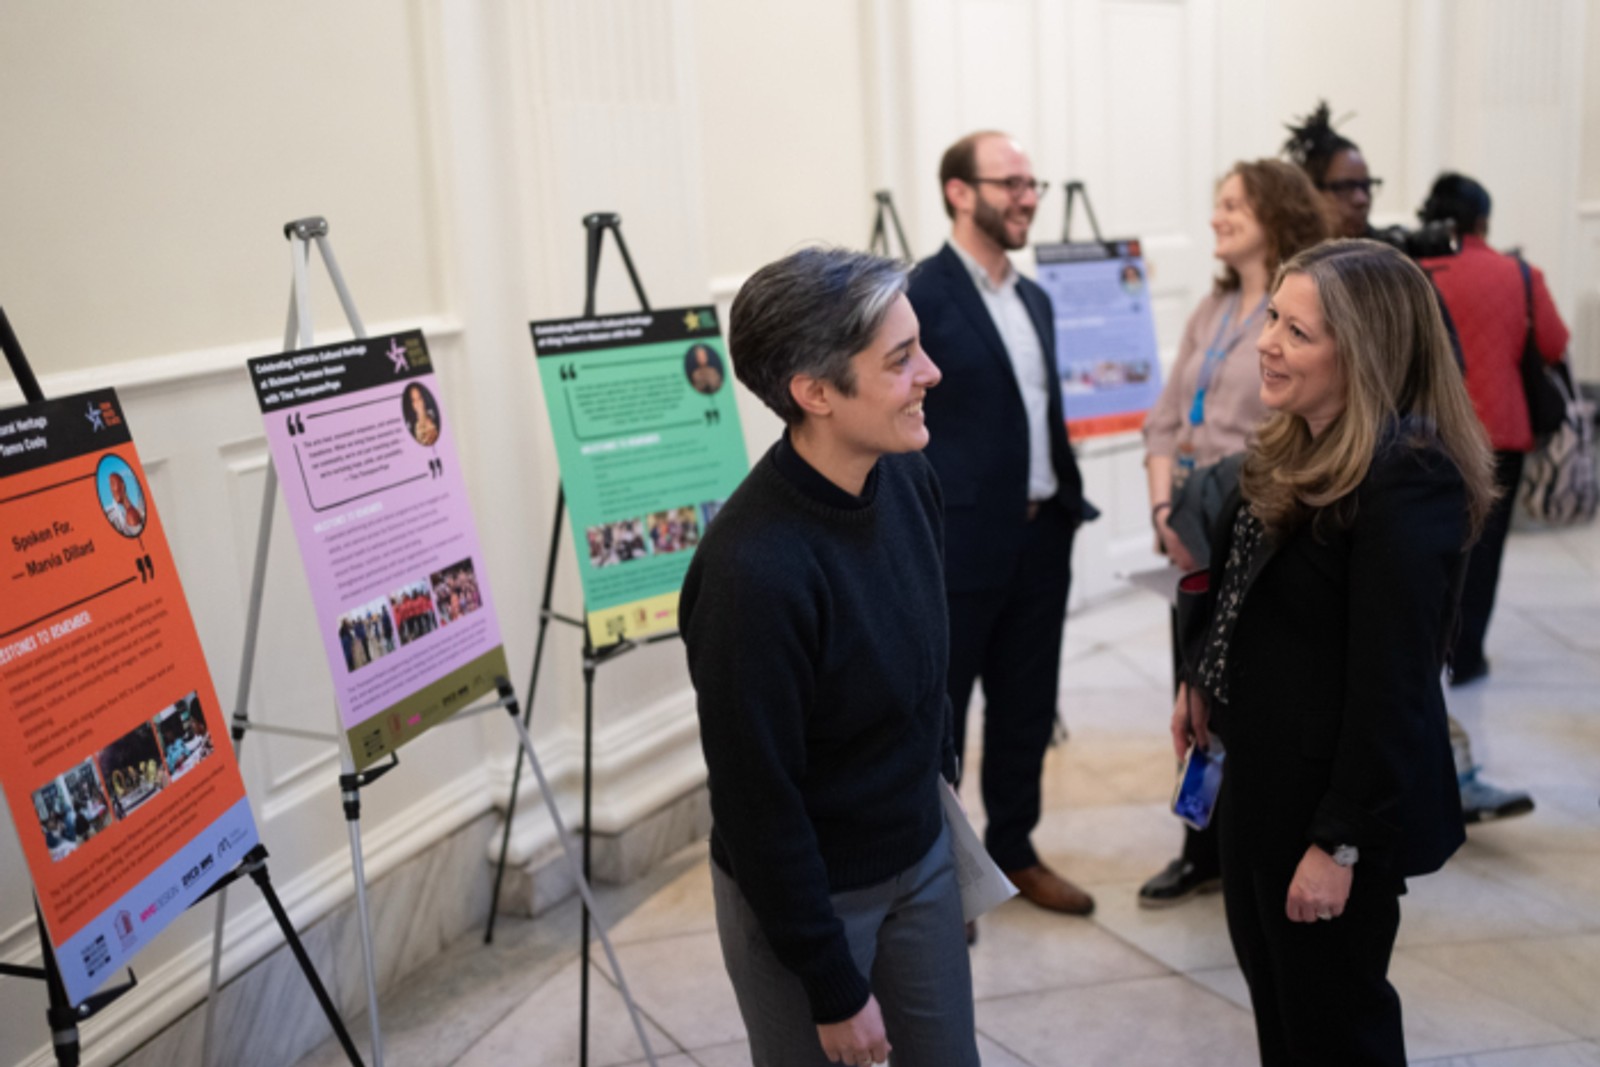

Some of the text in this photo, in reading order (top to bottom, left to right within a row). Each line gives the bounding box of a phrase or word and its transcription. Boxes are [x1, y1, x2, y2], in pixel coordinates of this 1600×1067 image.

[11, 521, 74, 552] Spoken For.
[25, 554, 63, 576] Marvia
[62, 539, 95, 562] Dillard
[37, 629, 51, 646] TO
